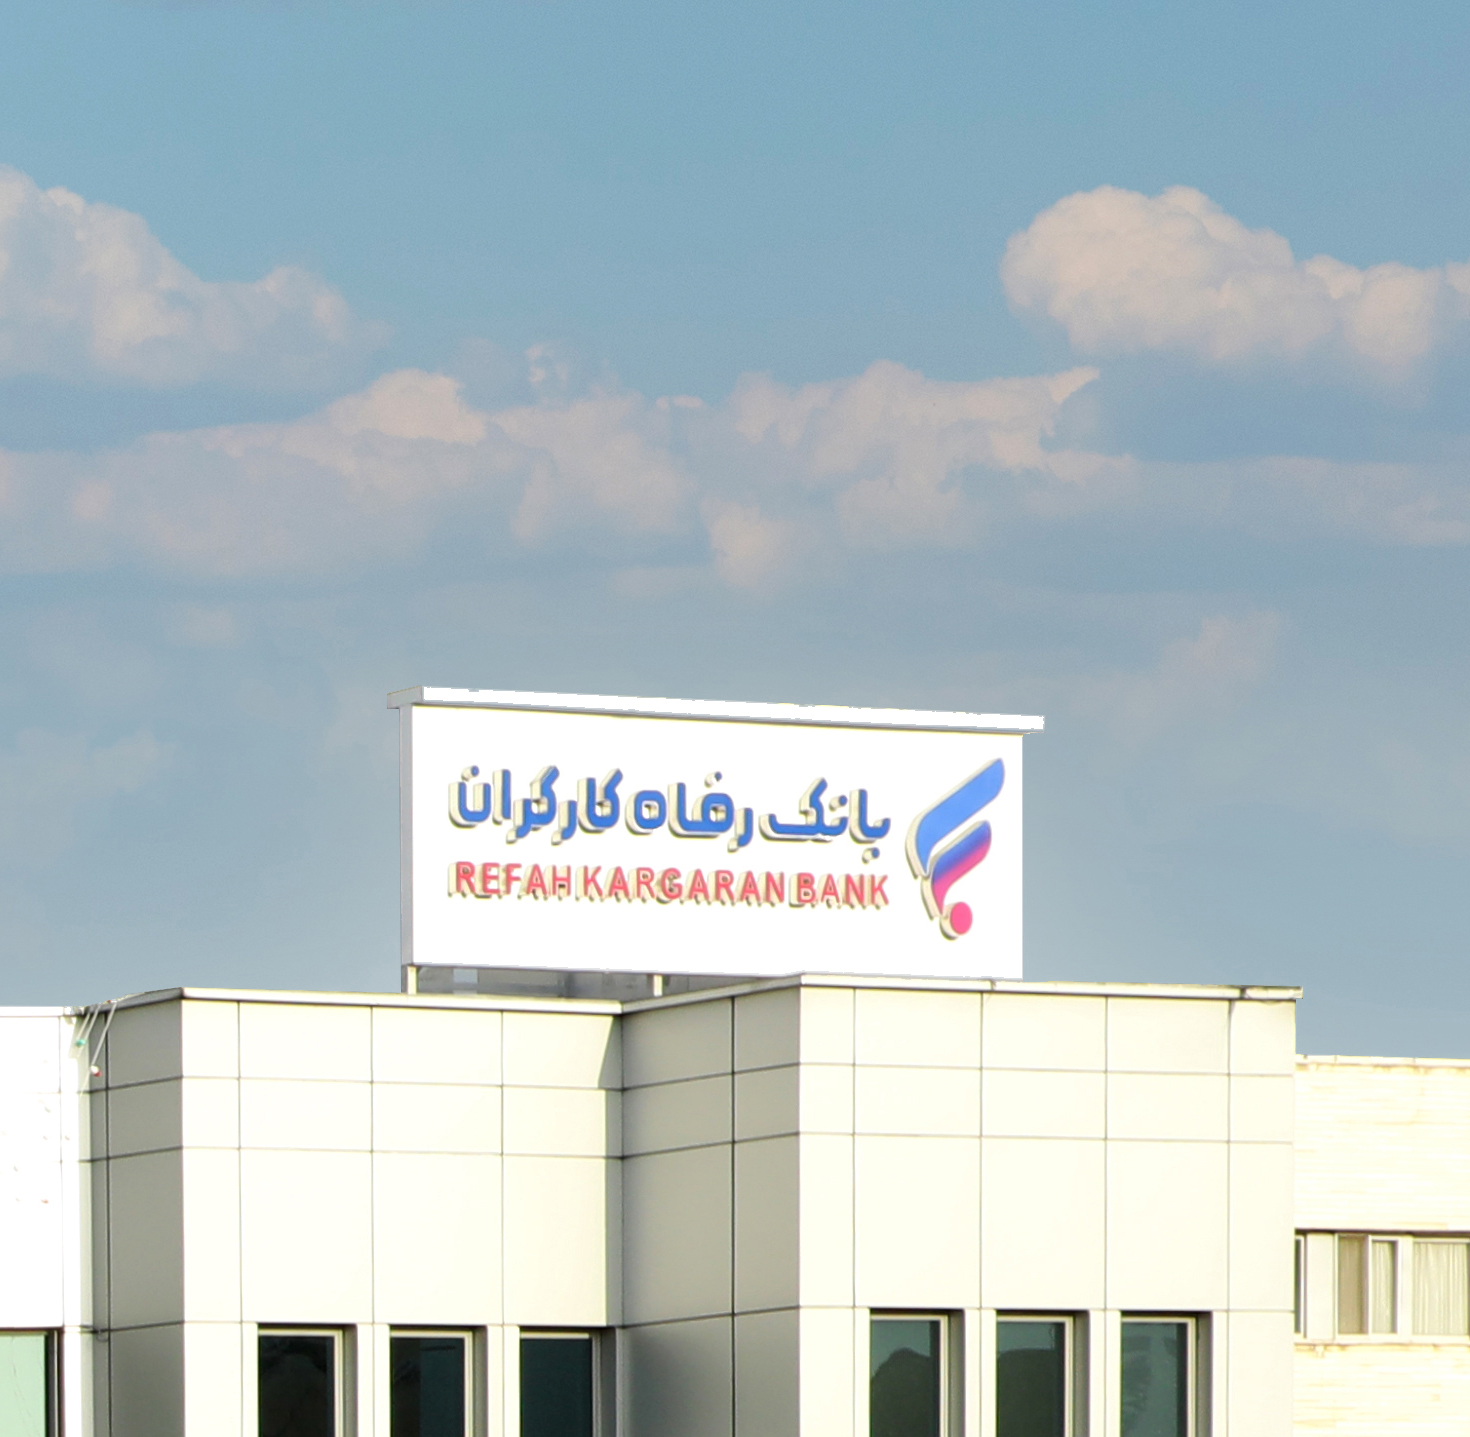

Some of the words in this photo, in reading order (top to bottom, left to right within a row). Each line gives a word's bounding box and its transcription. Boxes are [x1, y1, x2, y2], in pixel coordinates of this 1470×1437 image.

[448, 765, 623, 844] کارگران
[626, 771, 754, 853] رفاه
[759, 777, 891, 862] بانک
[448, 861, 572, 900] REFAH
[575, 865, 785, 905] KARGARAN
[790, 873, 890, 909] BANK
